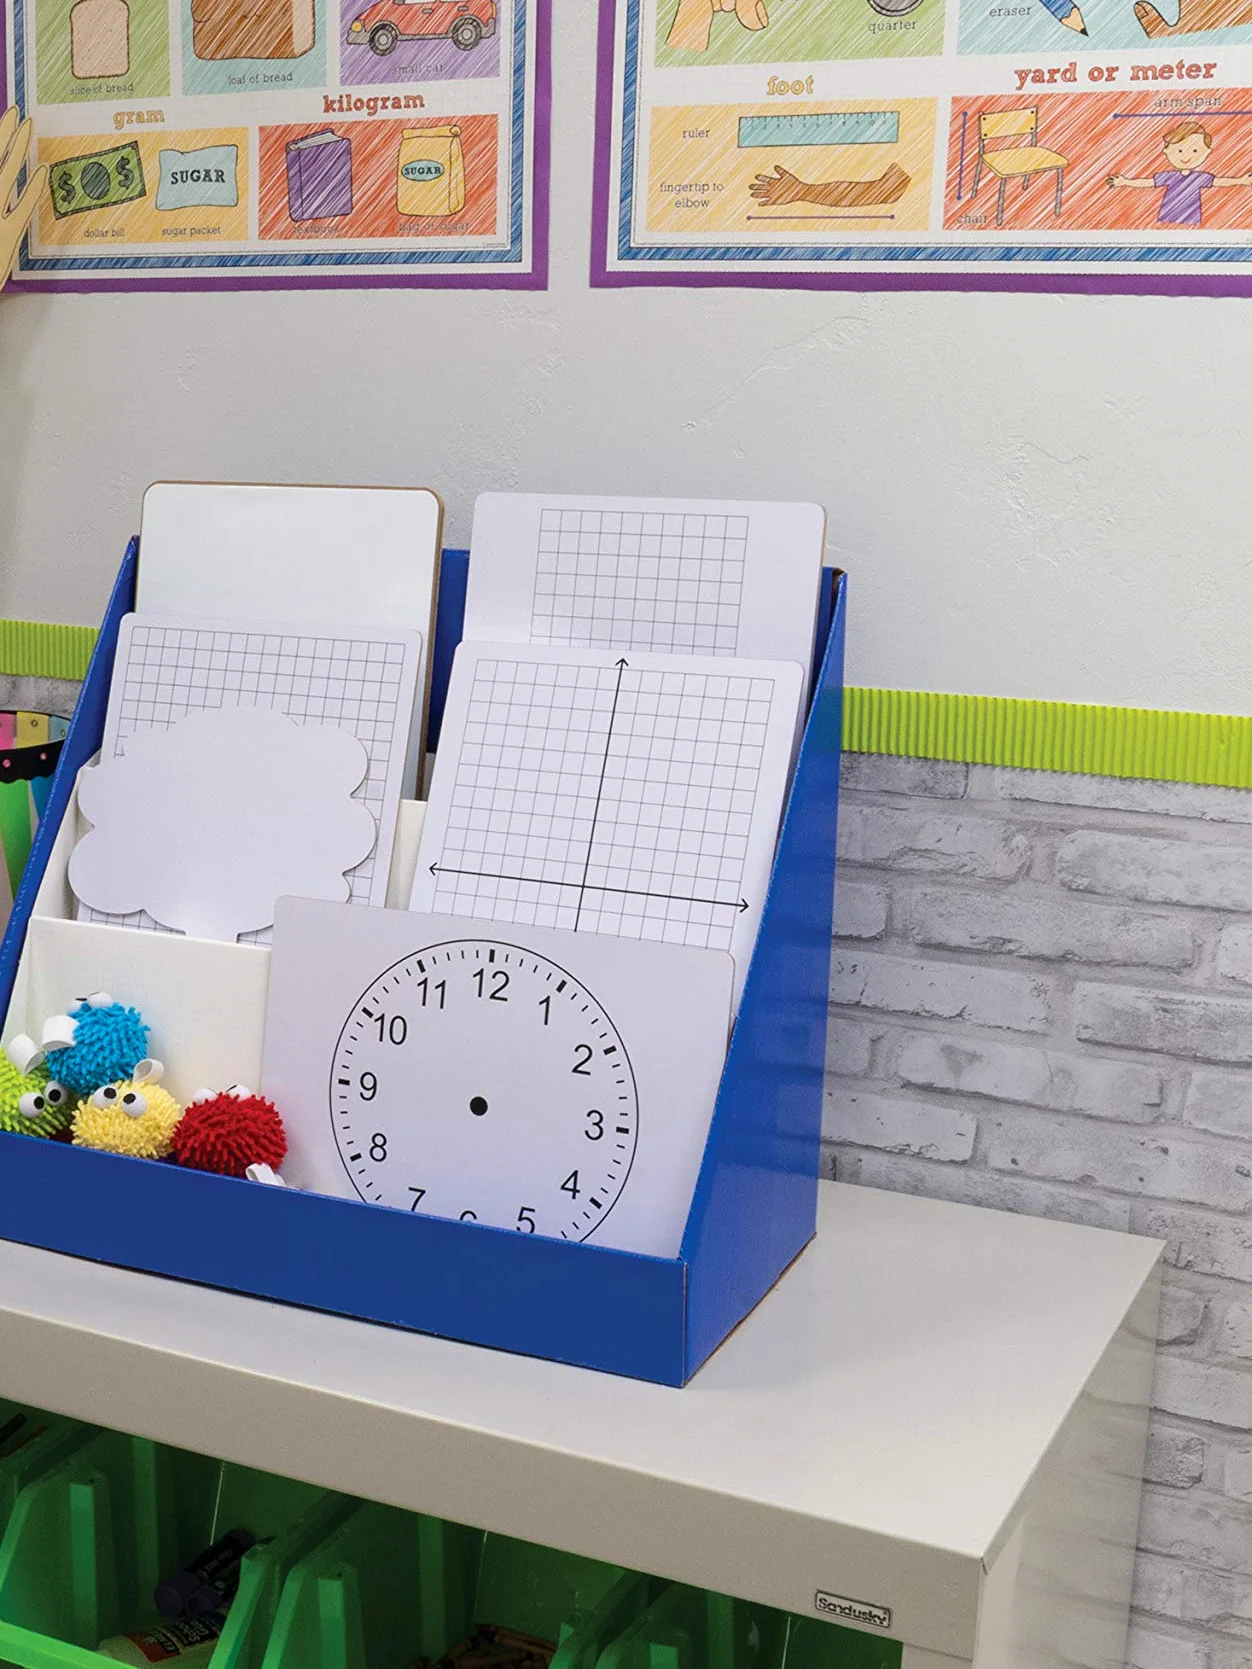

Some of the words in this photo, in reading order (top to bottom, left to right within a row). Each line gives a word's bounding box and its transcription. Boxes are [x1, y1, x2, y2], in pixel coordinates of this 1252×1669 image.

[989, 6, 1032, 17] eraser
[867, 20, 916, 33] quarter
[228, 74, 246, 85] loaf
[249, 73, 261, 83] of
[263, 71, 293, 83] bread
[391, 64, 422, 76] small
[1014, 62, 1077, 90] yard
[1088, 65, 1119, 82] or
[1130, 59, 1217, 82] meter
[106, 82, 134, 94] bread
[767, 75, 814, 96] foot
[323, 93, 426, 117] kilogram
[1154, 97, 1183, 108] arm
[1186, 96, 1222, 109] span
[113, 108, 165, 130] gram
[682, 128, 710, 139] ruler
[171, 169, 226, 185] SUGAR
[404, 165, 443, 176] SUGAR
[659, 182, 710, 194] fingertip
[713, 182, 724, 192] to
[675, 197, 710, 208] elbow
[957, 214, 989, 225] chair
[416, 977, 447, 1010] 11
[472, 967, 510, 1002] 12
[538, 995, 551, 1026] 1
[374, 1013, 408, 1045] 10
[571, 1043, 593, 1076] 2
[359, 1071, 378, 1101] 9
[584, 1109, 604, 1141] 3
[369, 1132, 388, 1162] 8
[560, 1169, 581, 1200] 4
[408, 1186, 426, 1212] 7
[516, 1206, 536, 1234] 5
